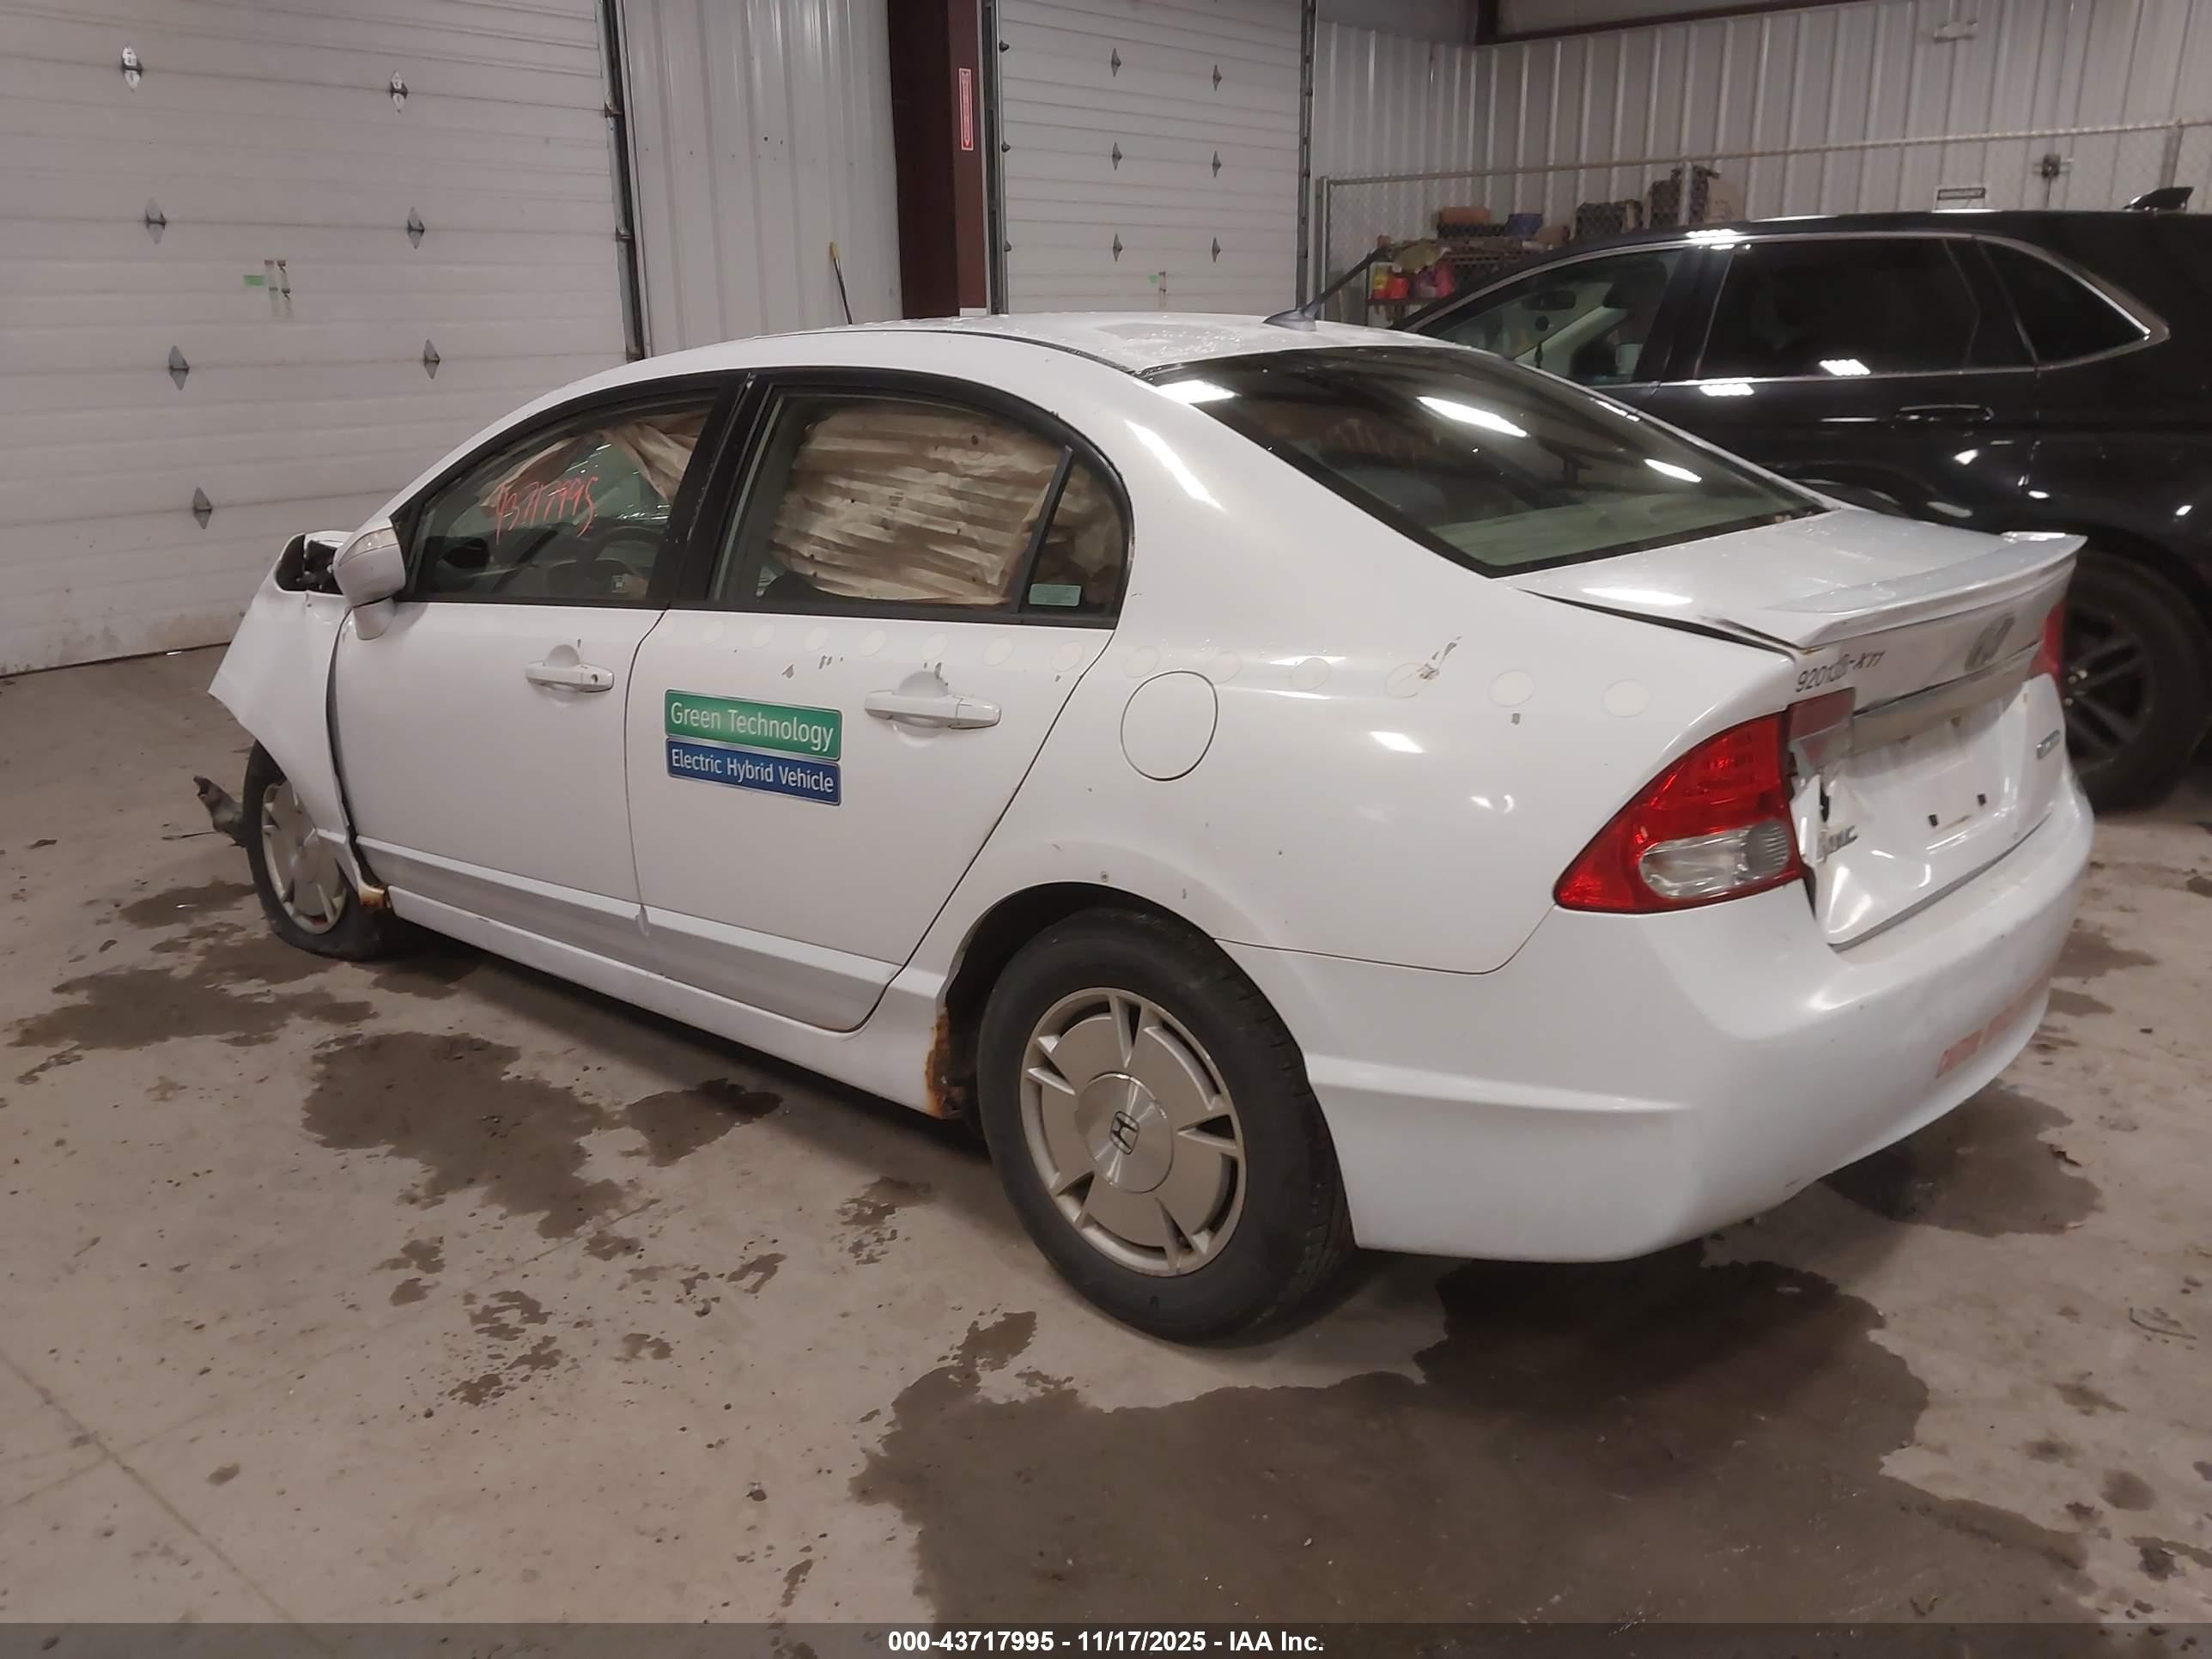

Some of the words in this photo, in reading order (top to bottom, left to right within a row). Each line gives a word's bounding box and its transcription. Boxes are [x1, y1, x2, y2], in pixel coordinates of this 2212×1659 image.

[671, 702, 721, 729] Green
[728, 709, 835, 752] Technology
[672, 748, 722, 774] Electric
[726, 757, 774, 782] Hybrid
[779, 765, 835, 793] Vehicle
